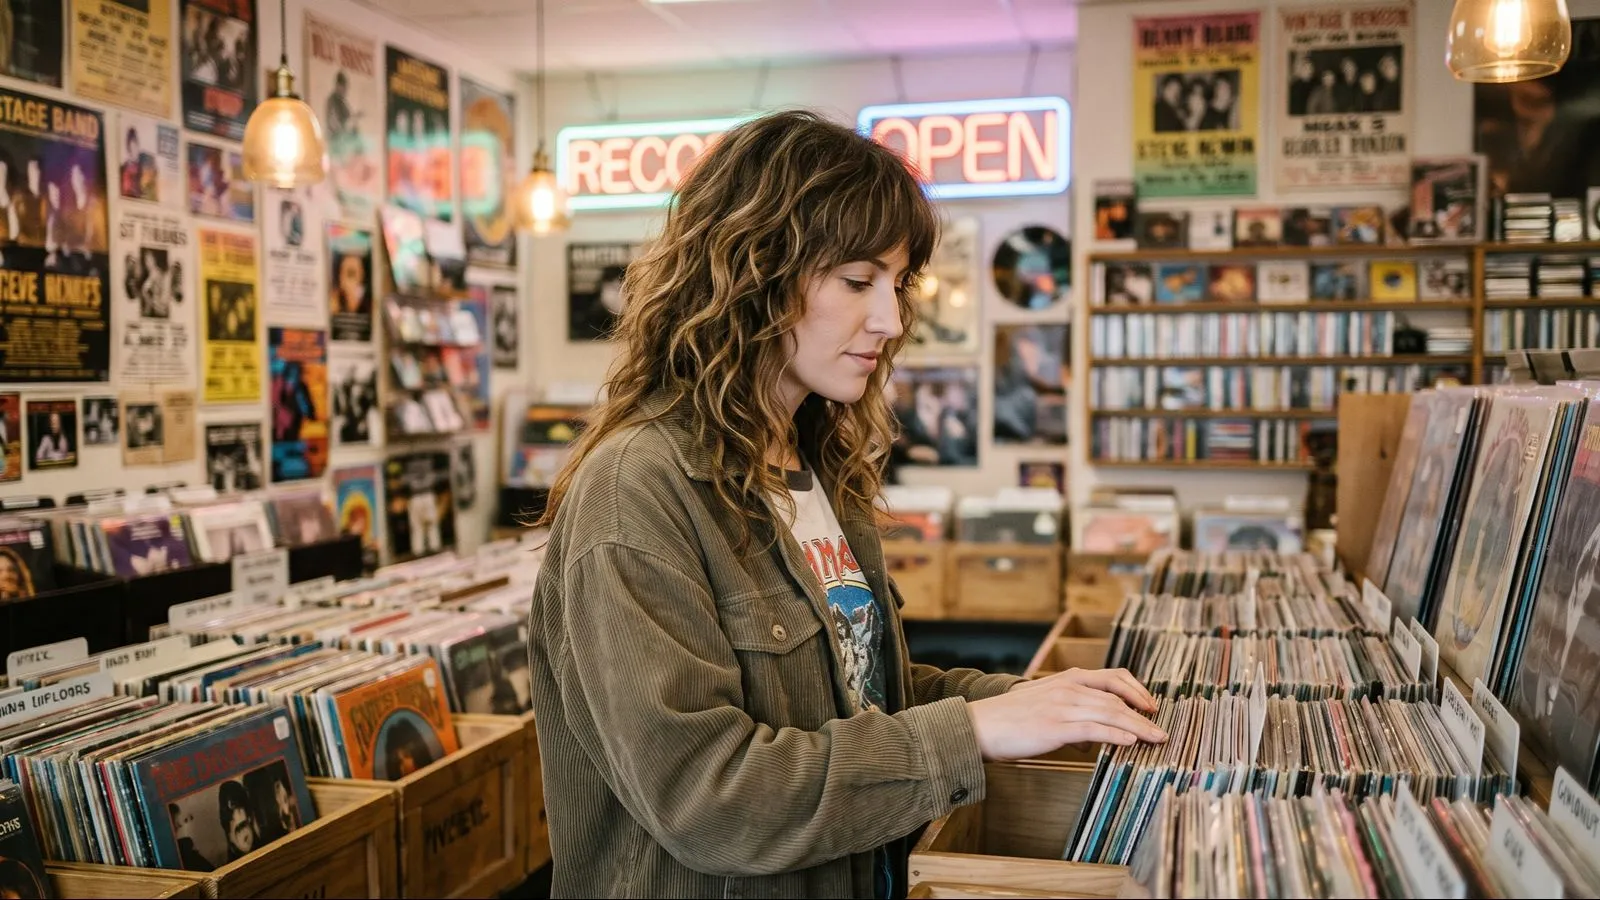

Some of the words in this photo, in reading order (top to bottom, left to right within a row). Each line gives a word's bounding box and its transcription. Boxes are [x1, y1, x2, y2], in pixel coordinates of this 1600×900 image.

[52, 105, 99, 141] BAND
[871, 111, 1058, 183] OPEN
[566, 134, 728, 195] RECO
